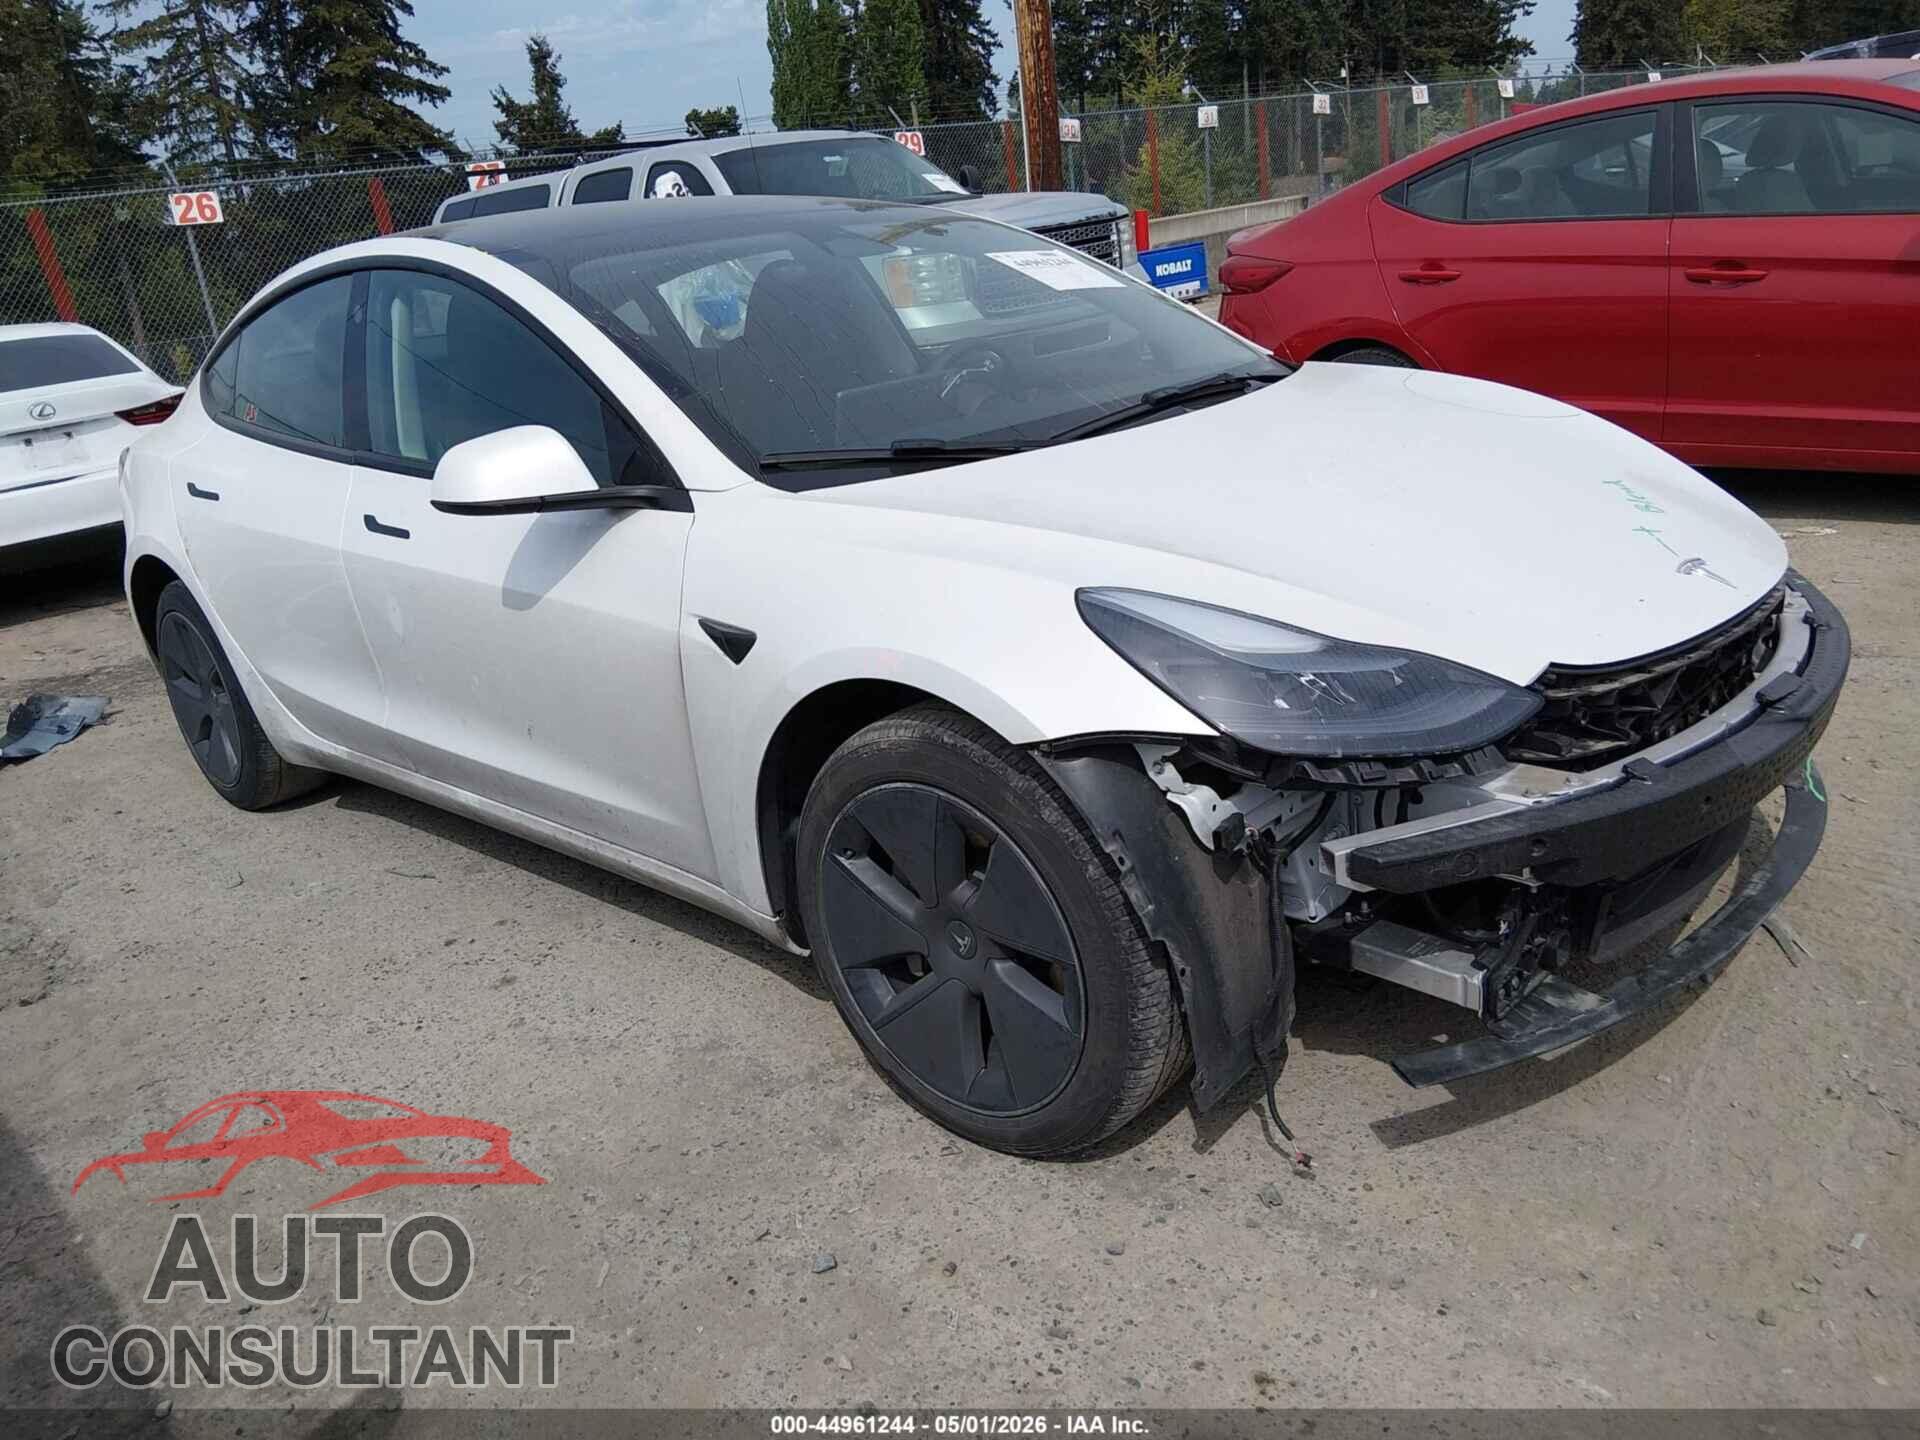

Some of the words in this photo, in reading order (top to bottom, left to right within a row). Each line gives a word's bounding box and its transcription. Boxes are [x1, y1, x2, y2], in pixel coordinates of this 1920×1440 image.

[1204, 112, 1214, 122] 31
[174, 193, 217, 223] 26
[1155, 259, 1192, 277] KOBALT
